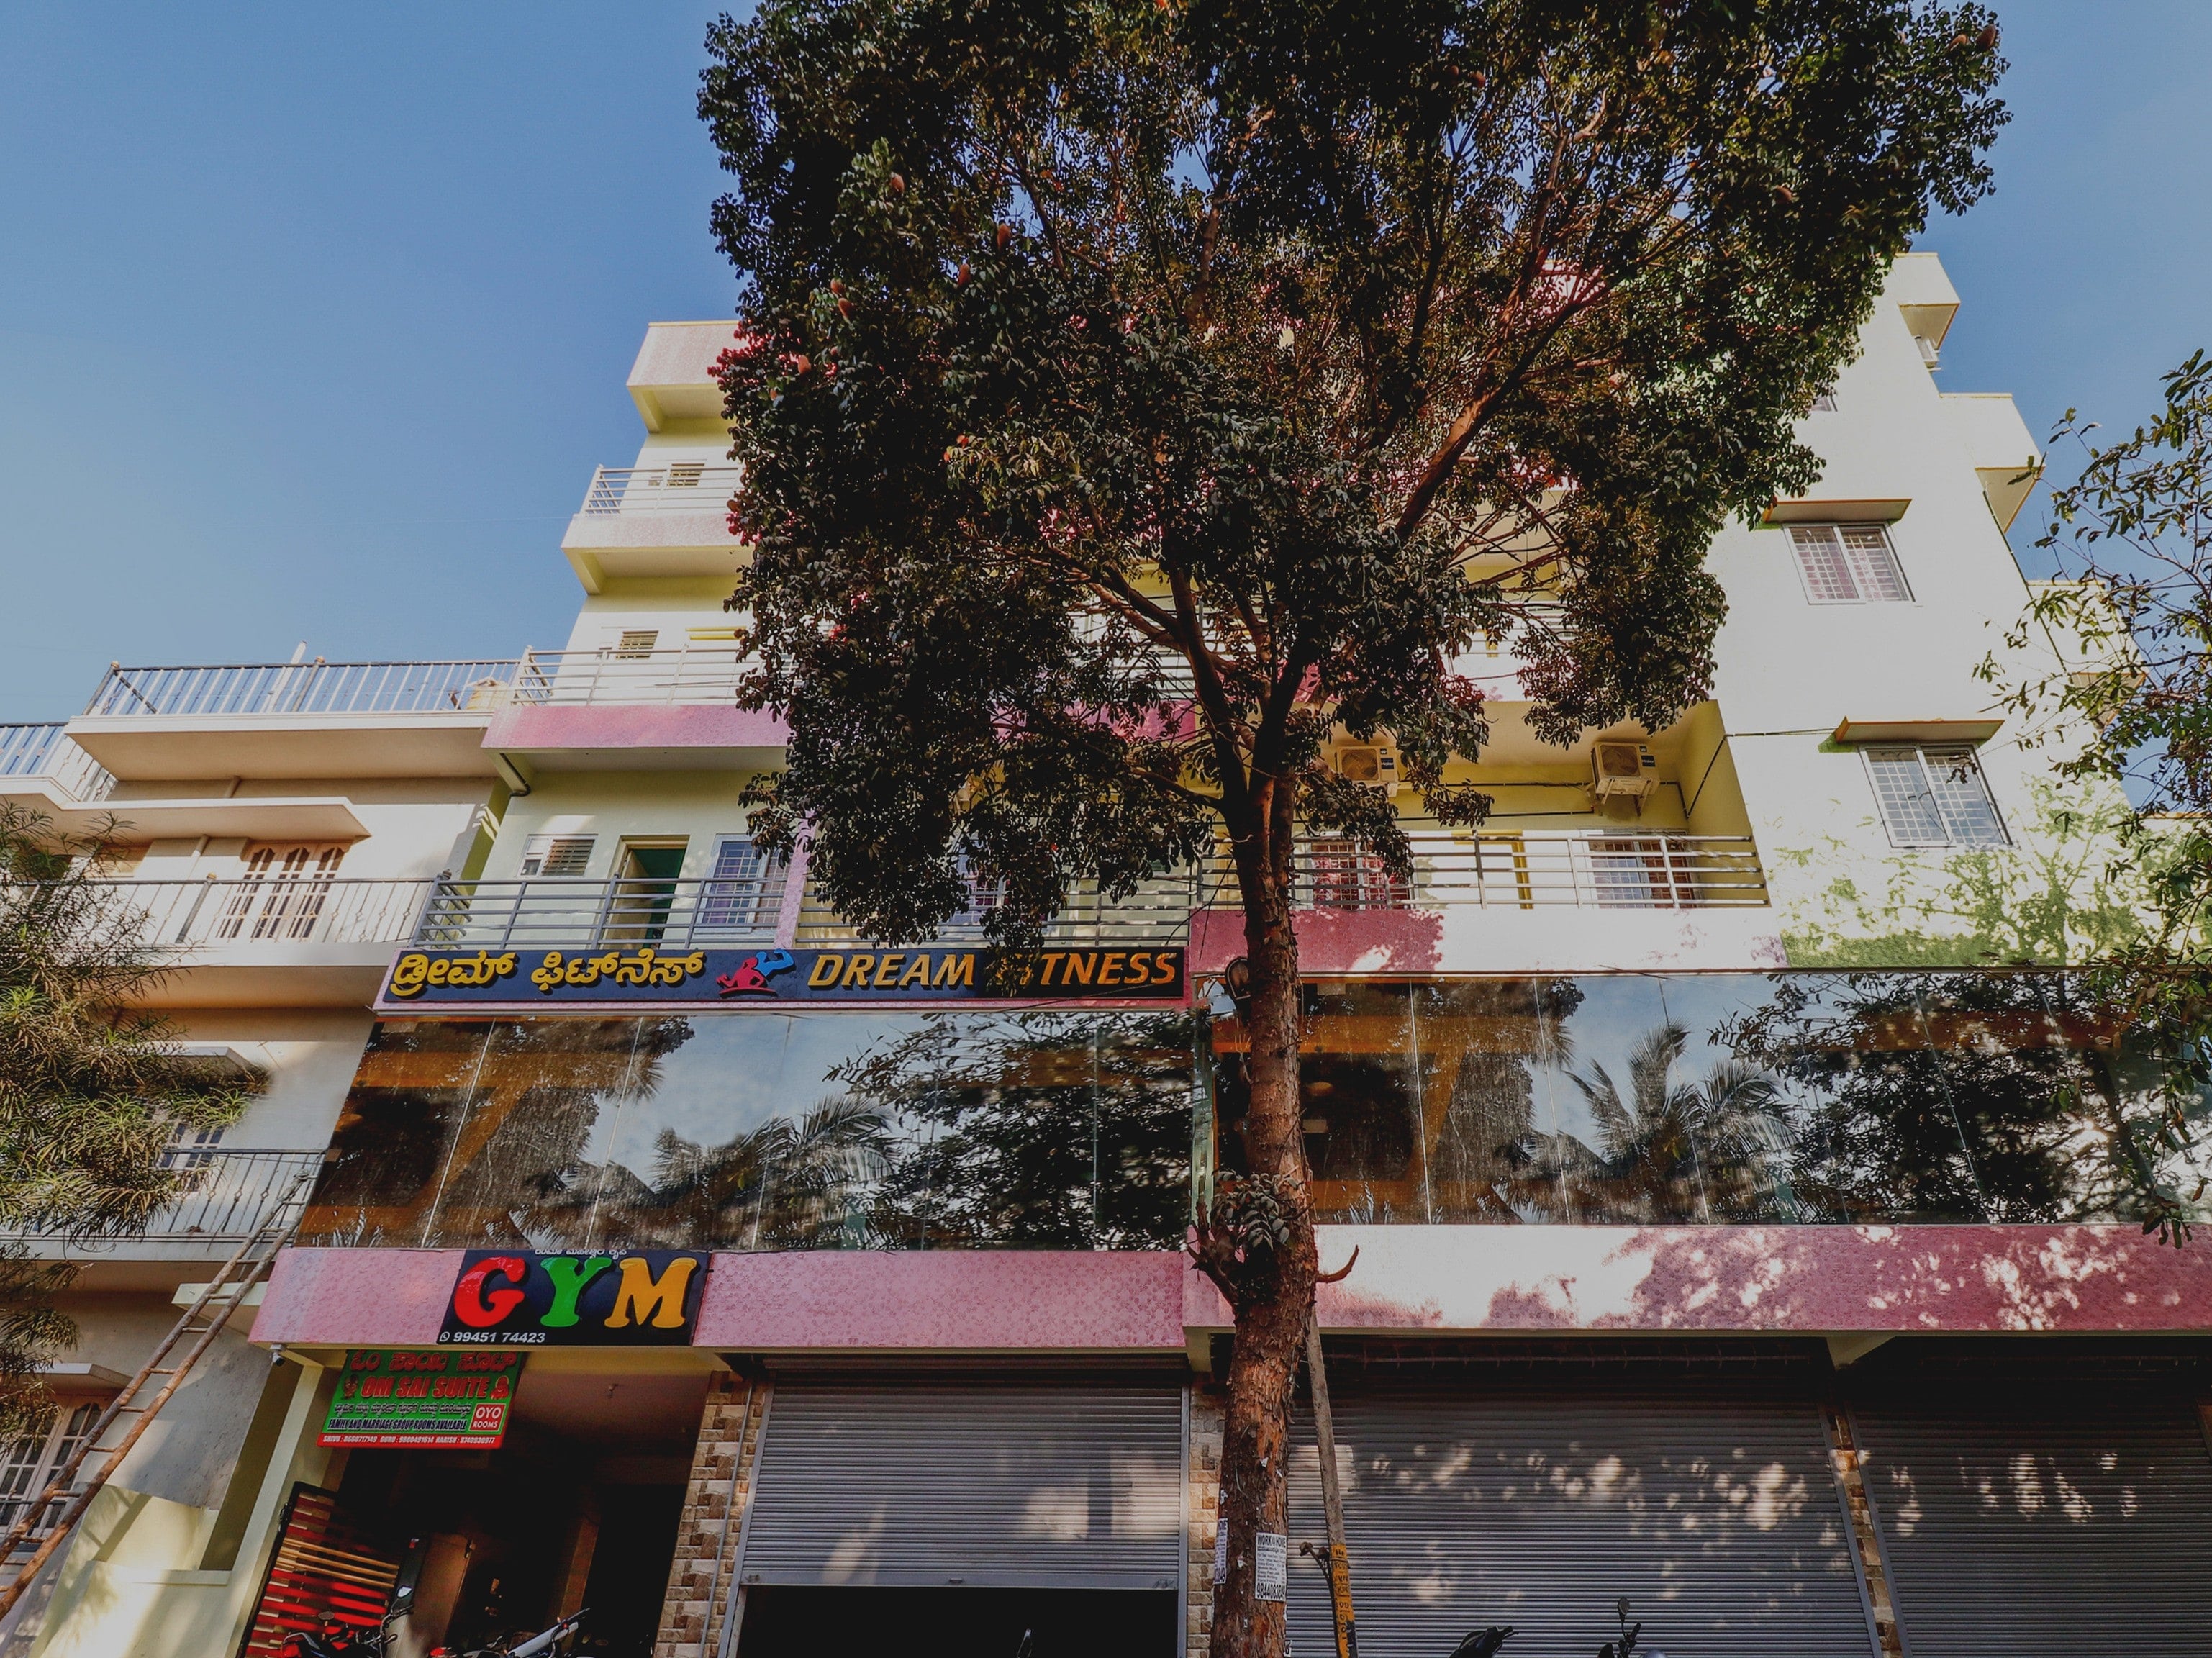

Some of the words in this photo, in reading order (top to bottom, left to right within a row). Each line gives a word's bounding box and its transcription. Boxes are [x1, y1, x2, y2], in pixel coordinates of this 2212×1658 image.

[390, 950, 515, 997] ಡ್ರೀಮ್
[807, 953, 974, 987] DREAM
[453, 1256, 697, 1329] GYM
[453, 1332, 497, 1343] 99451
[502, 1332, 545, 1343] 74423
[361, 1376, 394, 1398] OM
[396, 1376, 432, 1398] SAI
[432, 1376, 491, 1399] SUITE
[476, 1406, 502, 1419] OYO
[328, 1418, 349, 1430] FAMILY
[348, 1418, 362, 1430] AND
[361, 1418, 393, 1430] MARRIAGE
[392, 1418, 414, 1431] GROUP
[414, 1419, 436, 1431] ROOMS
[435, 1419, 467, 1431] AVAILABLE
[1258, 1534, 1272, 1546] WORK
[1276, 1536, 1286, 1548] HOME
